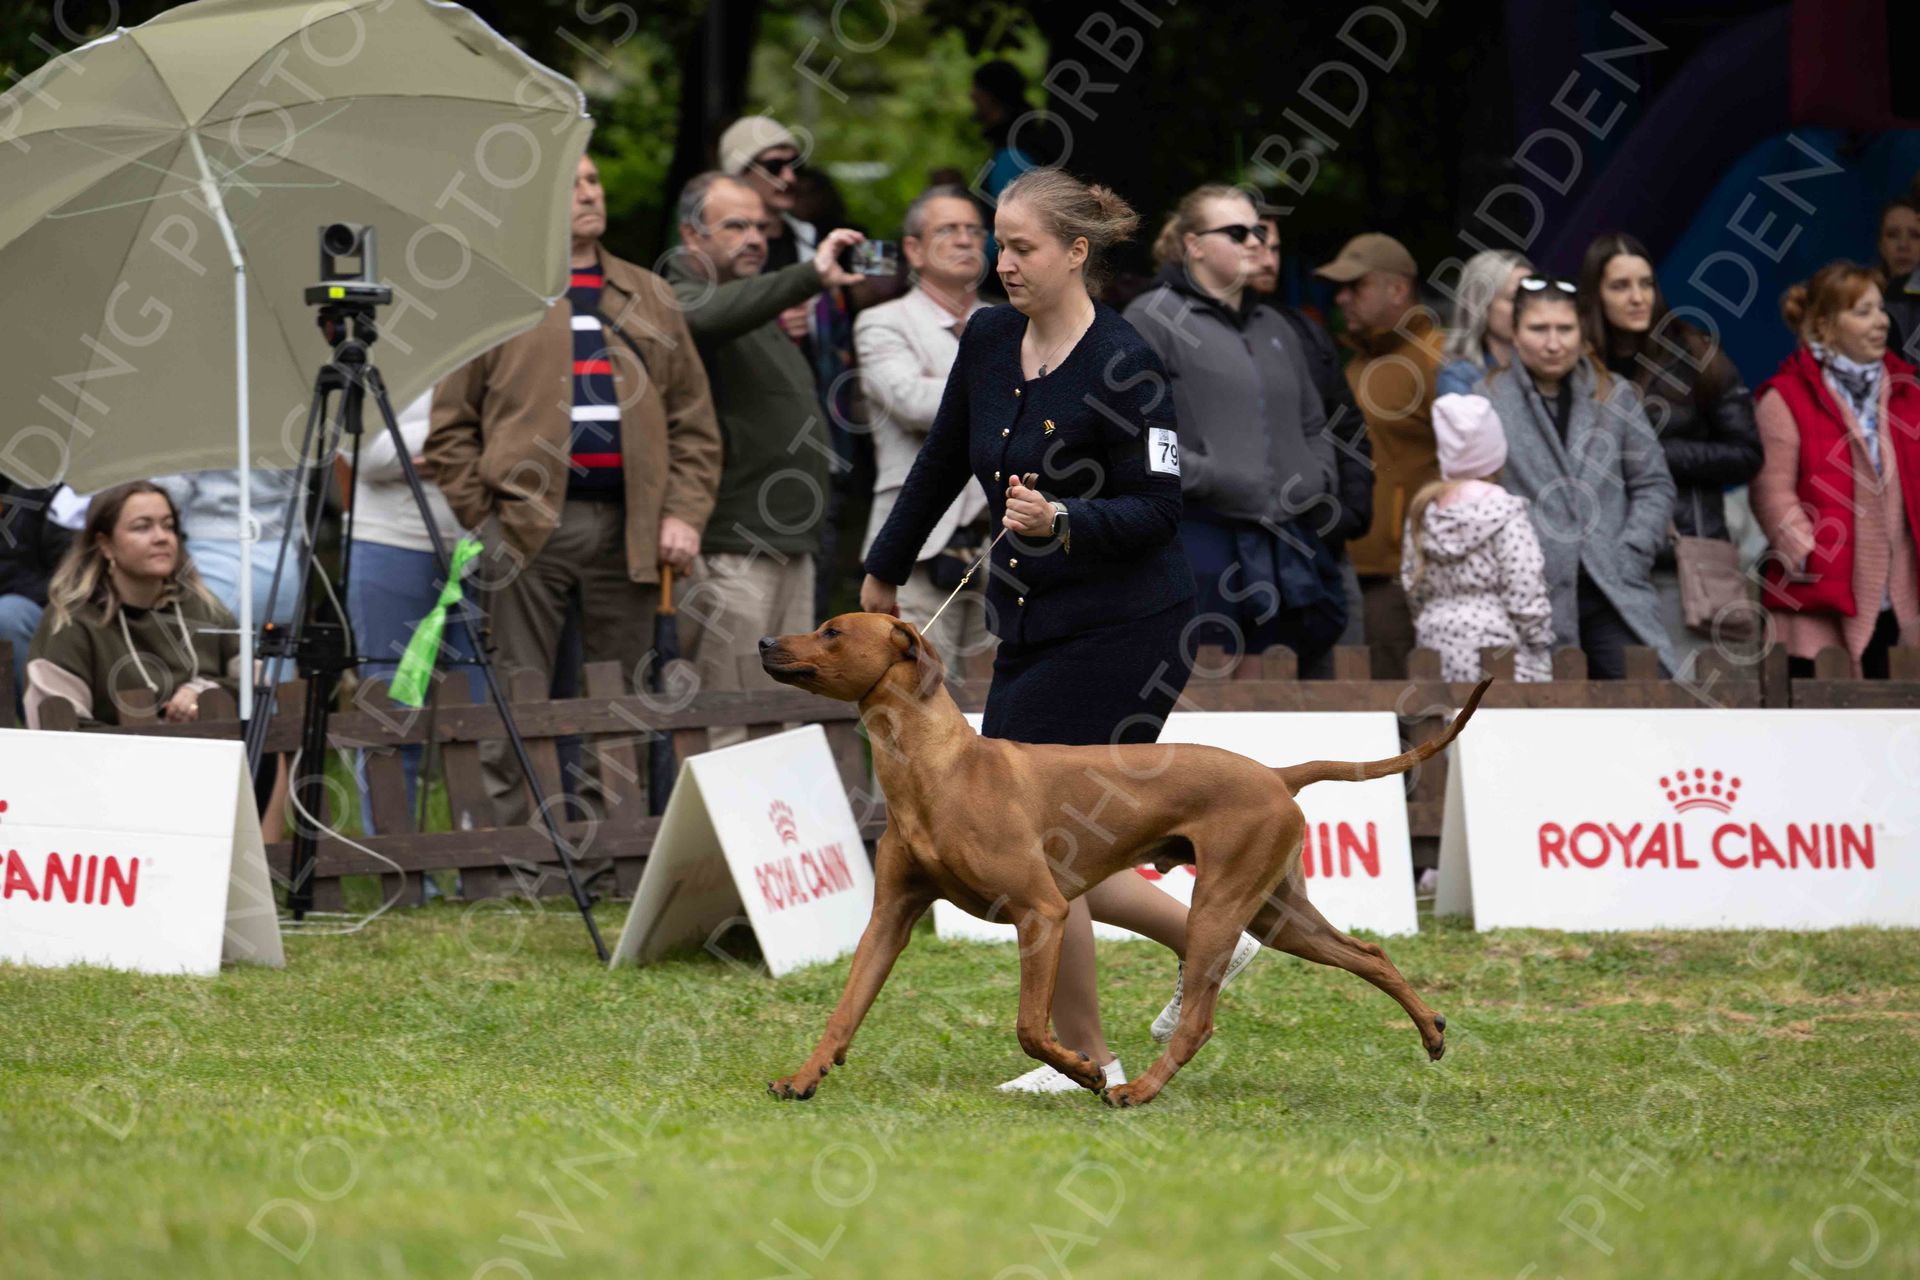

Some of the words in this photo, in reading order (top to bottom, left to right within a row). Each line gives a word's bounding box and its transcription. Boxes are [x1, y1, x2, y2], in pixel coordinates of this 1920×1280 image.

[1157, 441, 1179, 467] 79
[1538, 822, 1700, 870] ROYAL
[1711, 822, 1875, 870] CANIN
[0, 849, 140, 907] ANIN
